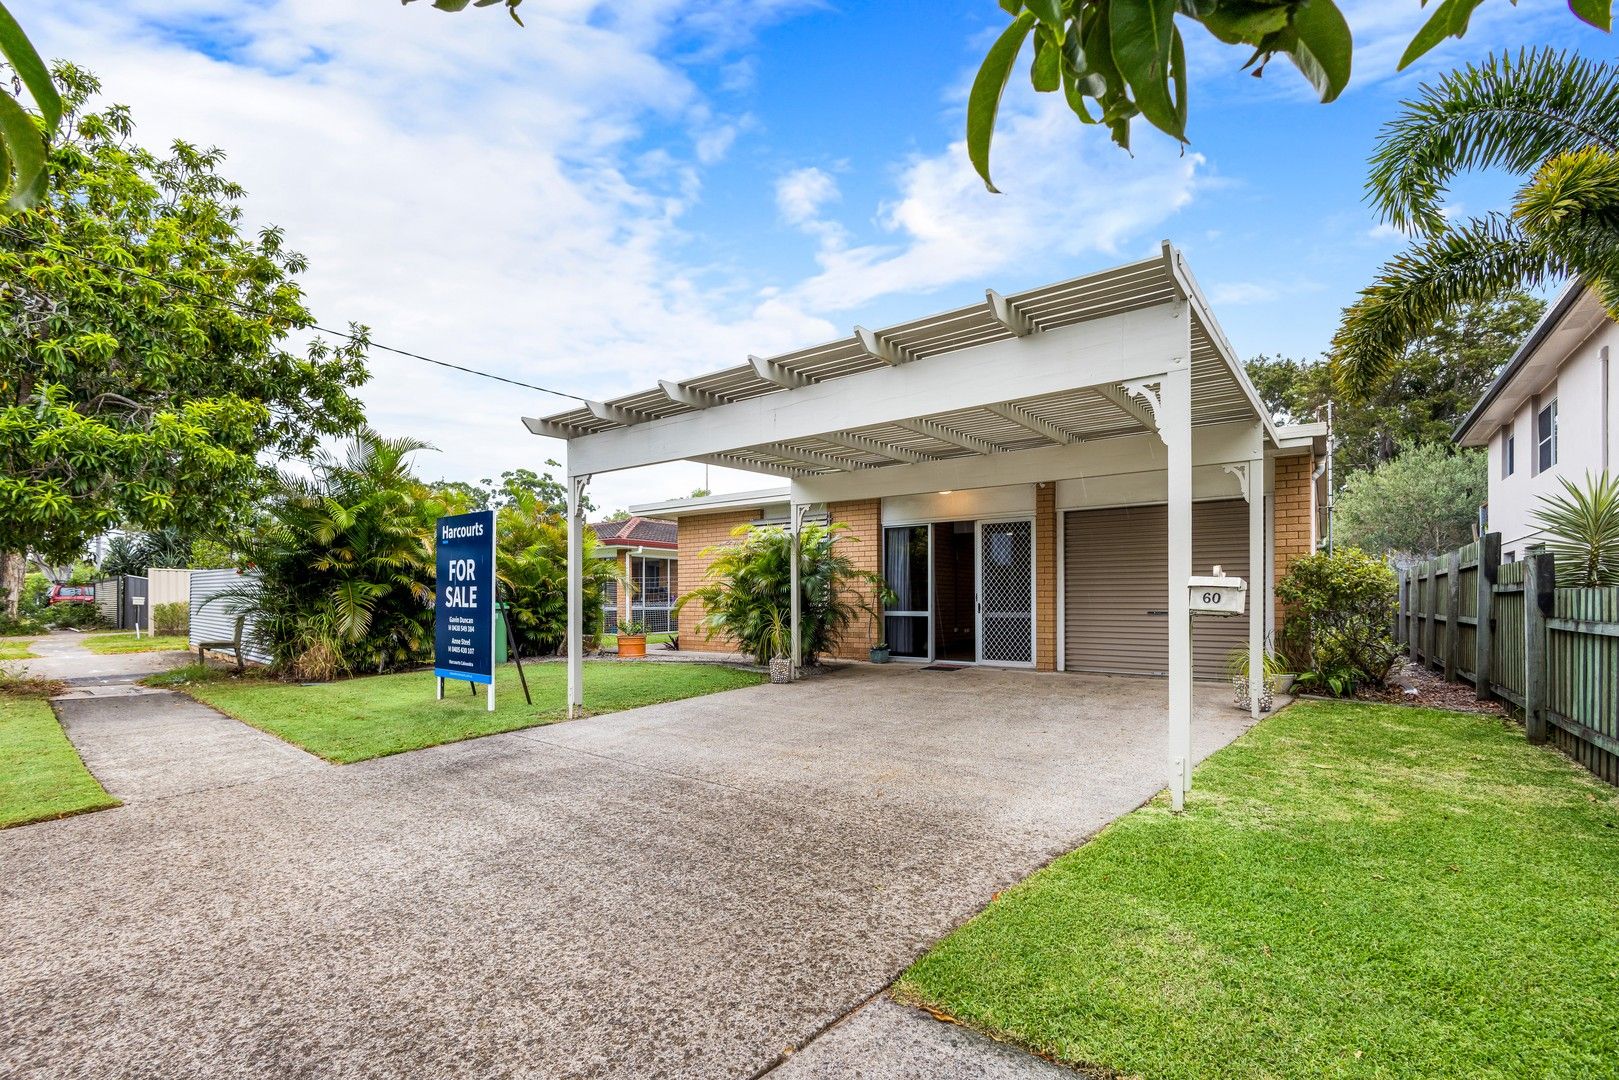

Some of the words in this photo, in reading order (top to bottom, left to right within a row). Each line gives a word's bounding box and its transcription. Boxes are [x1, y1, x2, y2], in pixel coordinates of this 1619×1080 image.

[442, 522, 484, 540] Harcourts
[448, 559, 476, 582] FOR
[445, 585, 478, 608] SALE
[1202, 592, 1221, 604] 60
